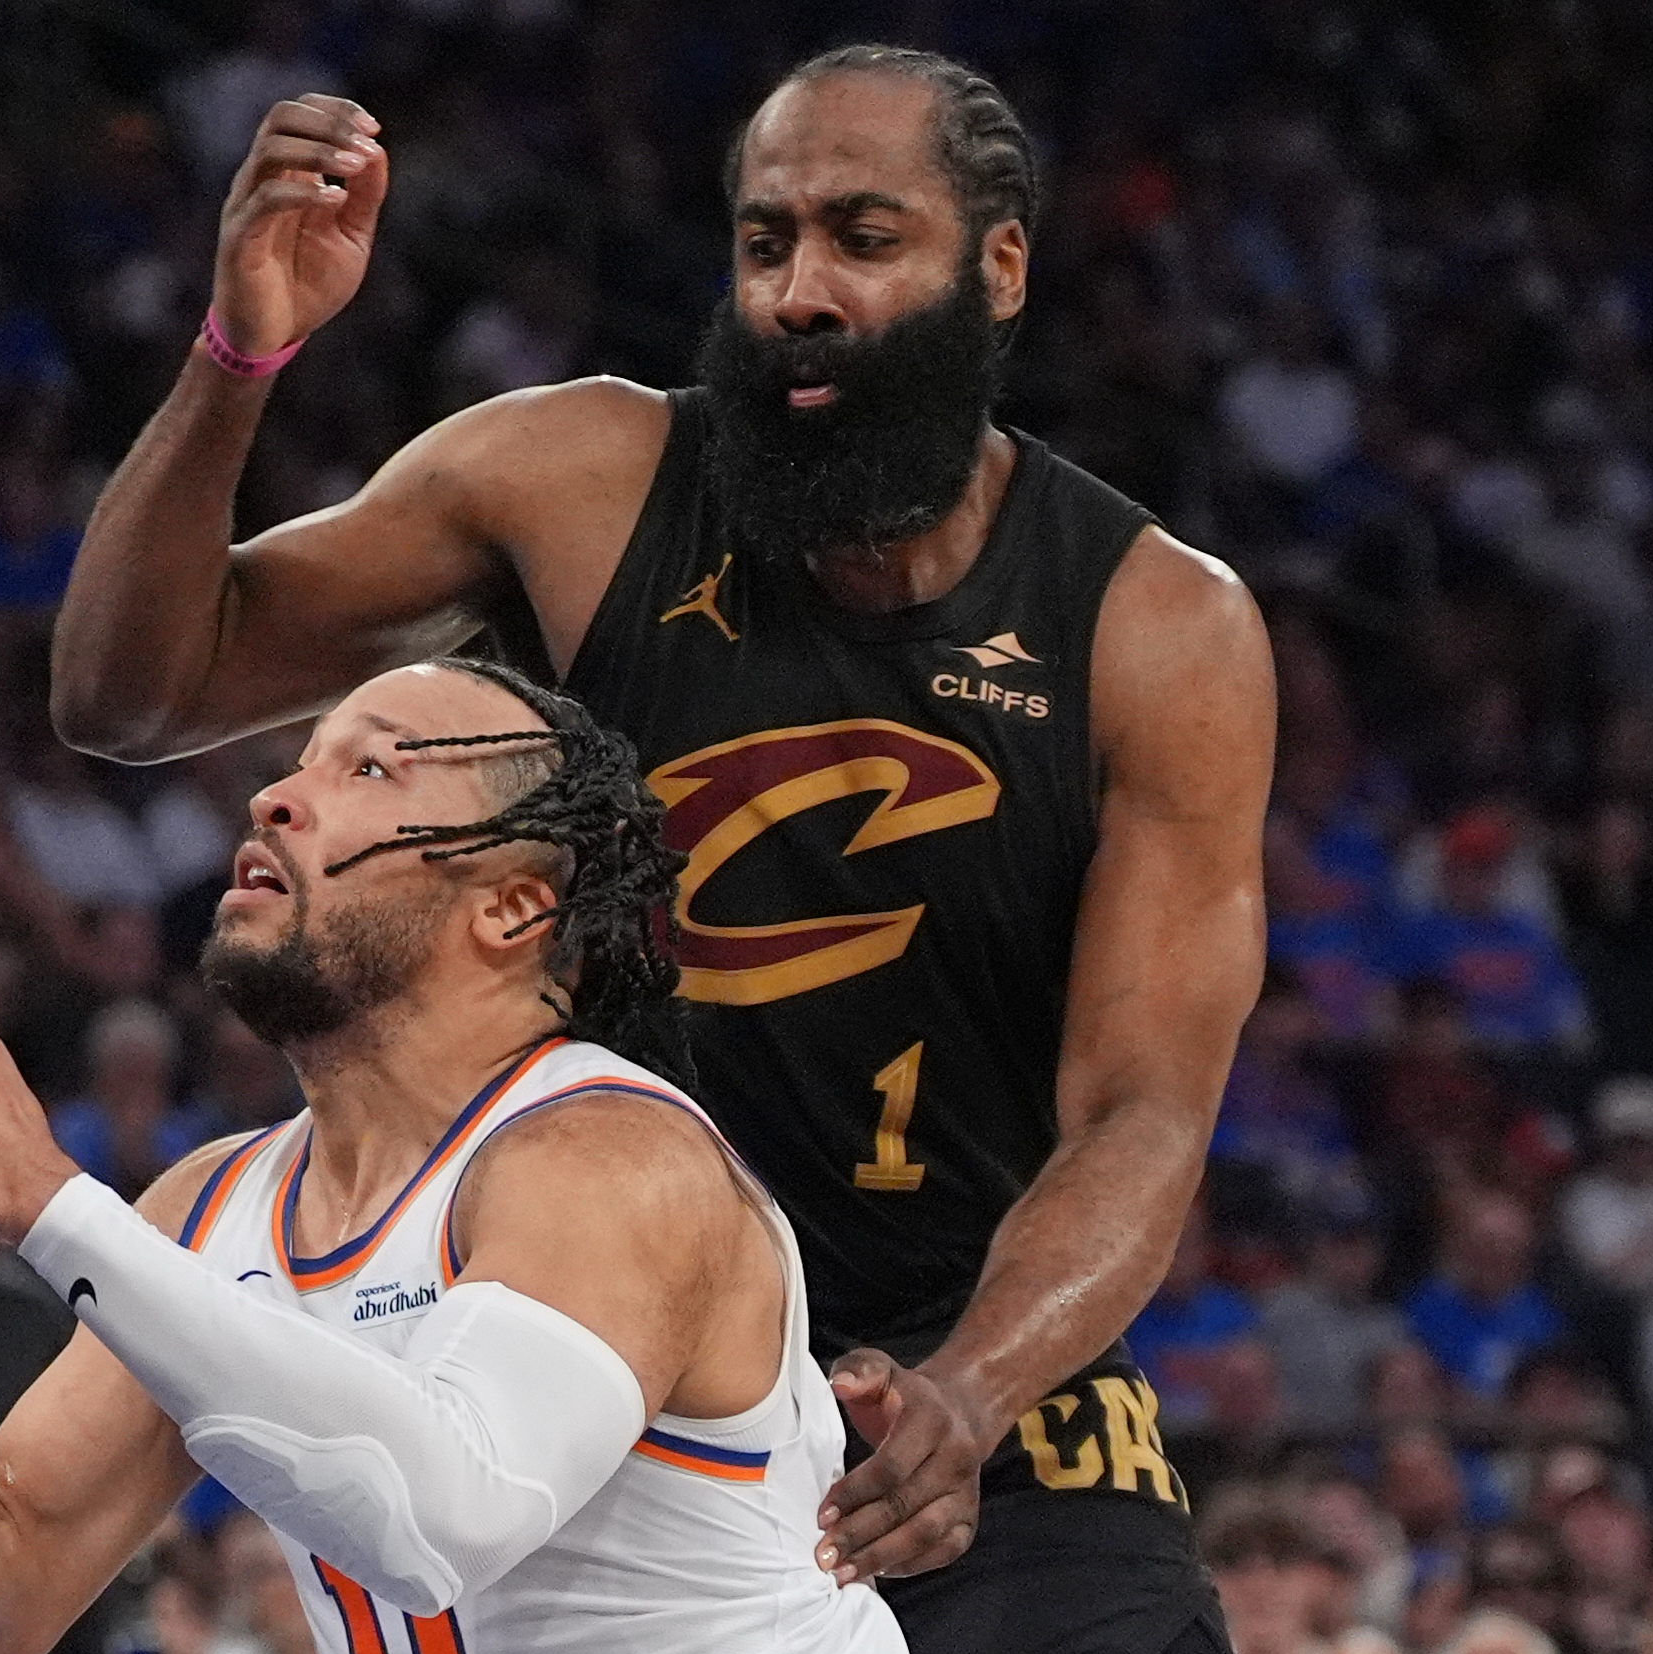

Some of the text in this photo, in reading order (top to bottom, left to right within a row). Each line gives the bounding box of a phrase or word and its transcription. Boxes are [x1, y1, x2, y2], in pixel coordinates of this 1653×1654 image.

[932, 672, 1051, 719] CLIFFS
[647, 717, 1002, 1006] C
[854, 1040, 925, 1191] 1
[354, 1281, 438, 1322] abu dhabi
[355, 1281, 401, 1300] experience
